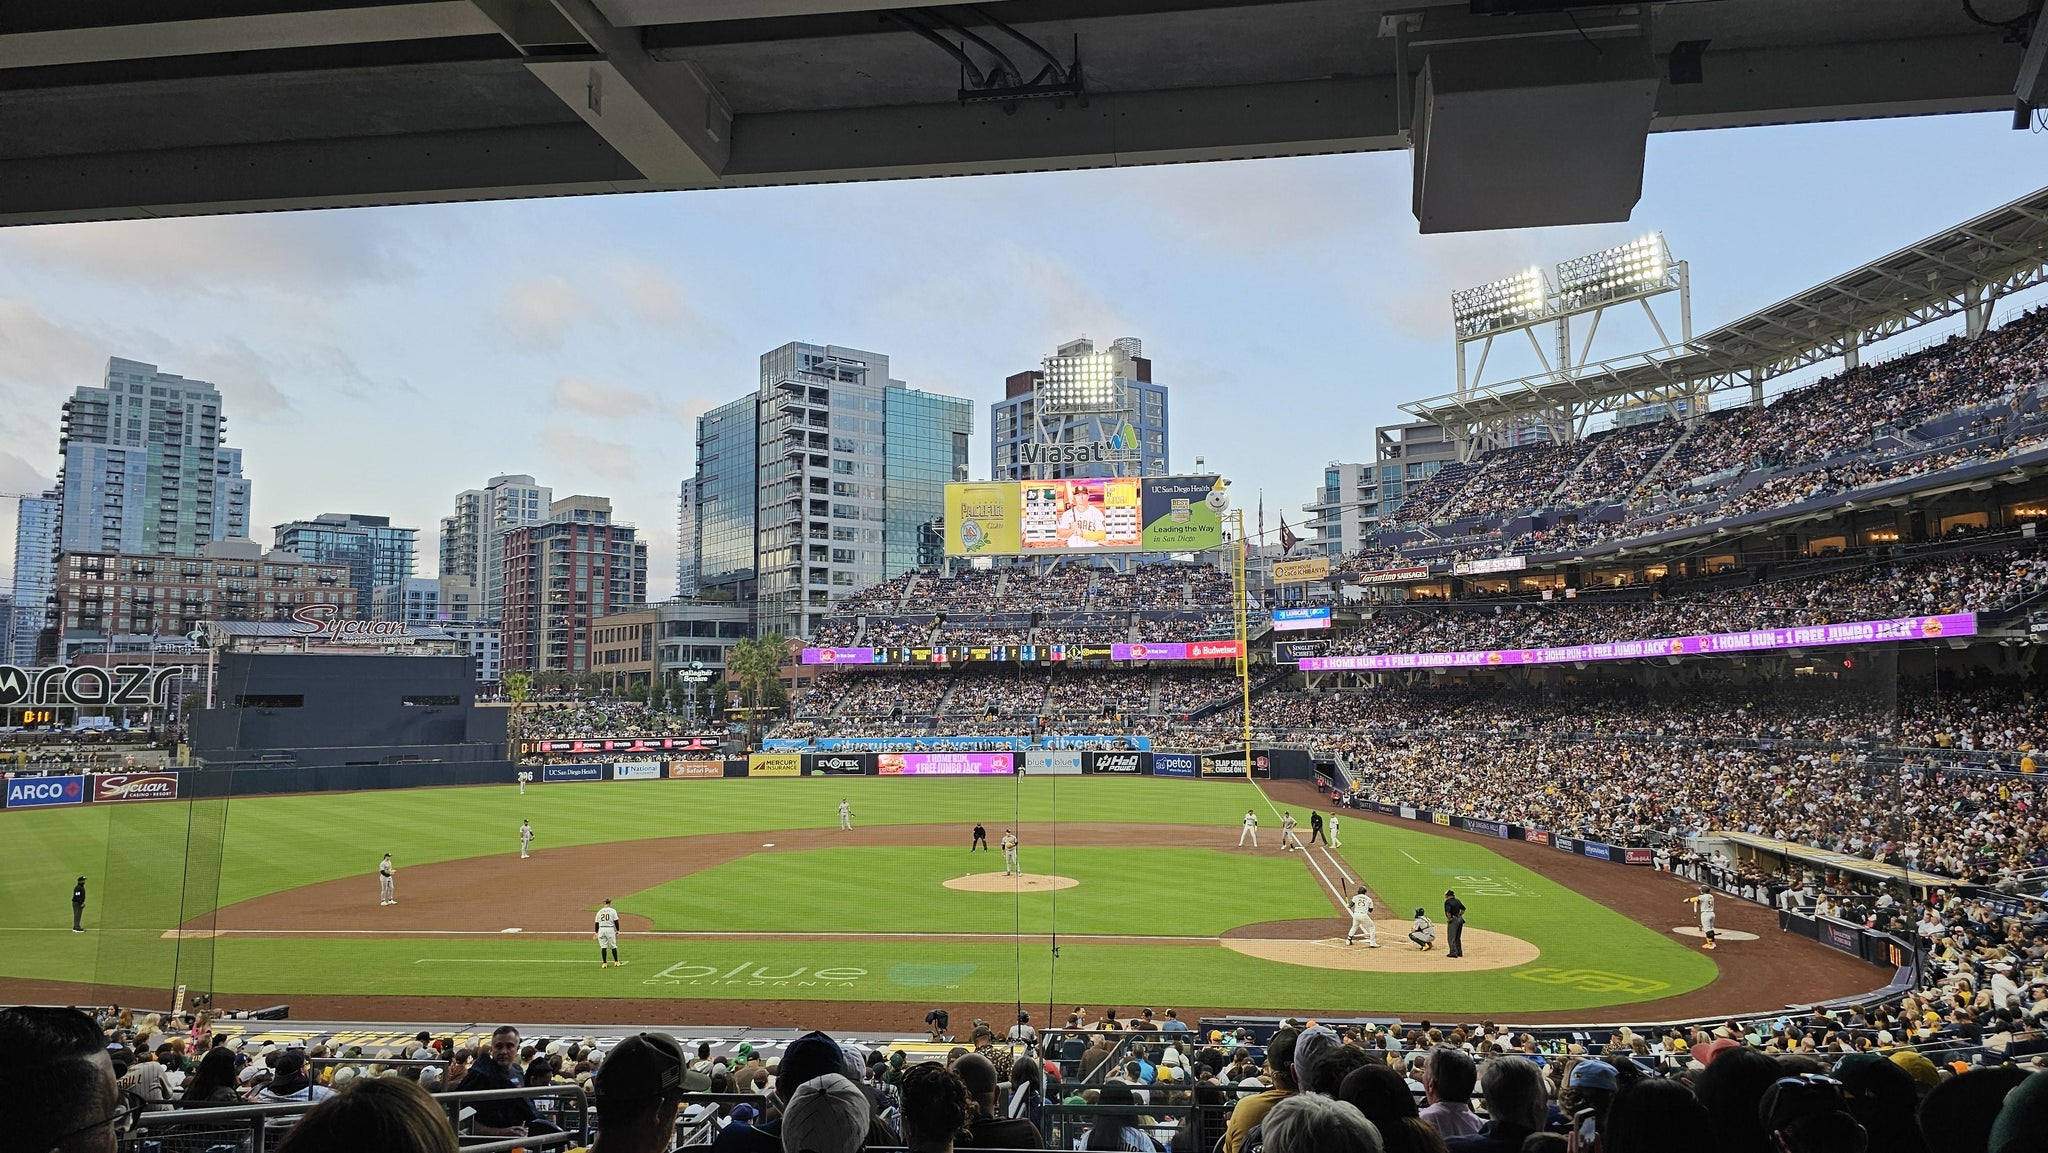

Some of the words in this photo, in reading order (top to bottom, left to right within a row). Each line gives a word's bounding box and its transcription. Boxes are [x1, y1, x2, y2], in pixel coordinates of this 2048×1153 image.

[1023, 441, 1104, 463] Viasat
[1174, 486, 1191, 494] Diego
[1154, 526, 1183, 534] Leading
[1199, 526, 1214, 534] Way
[1361, 572, 1396, 583] Tarantino
[1397, 571, 1427, 580] SAUSAGES
[291, 604, 411, 644] Sycuan
[1712, 636, 1718, 650] 1
[1720, 634, 1750, 649] HOME
[1752, 633, 1775, 647] RUN
[1786, 632, 1792, 644] 1
[1795, 630, 1824, 644] FREE
[1827, 626, 1873, 642] JUMBO
[893, 651, 898, 659] F
[952, 650, 957, 658] F
[1012, 649, 1016, 657] F
[1042, 649, 1046, 657] F
[1203, 646, 1236, 654] Budweiser
[1567, 648, 1581, 660] RUN
[1588, 647, 1592, 658] 1
[1594, 646, 1612, 658] FREE
[1614, 644, 1642, 656] JUMBO
[1323, 658, 1328, 668] 1
[1330, 658, 1356, 668] HOME
[1357, 657, 1376, 667] RUN
[1385, 656, 1390, 666] 1
[1392, 656, 1415, 666] FREE
[1417, 654, 1452, 665] JUMBO
[34, 666, 183, 706] razr
[818, 758, 859, 769] EVOTEK
[931, 754, 954, 762] HOME
[921, 762, 937, 773] FREE
[938, 762, 962, 773] JUMBO
[1166, 760, 1192, 770] petco
[10, 783, 63, 800] ARCO
[101, 777, 169, 798] Sycuan
[653, 961, 869, 980] blue
[642, 979, 854, 988] CALIFORNIA
